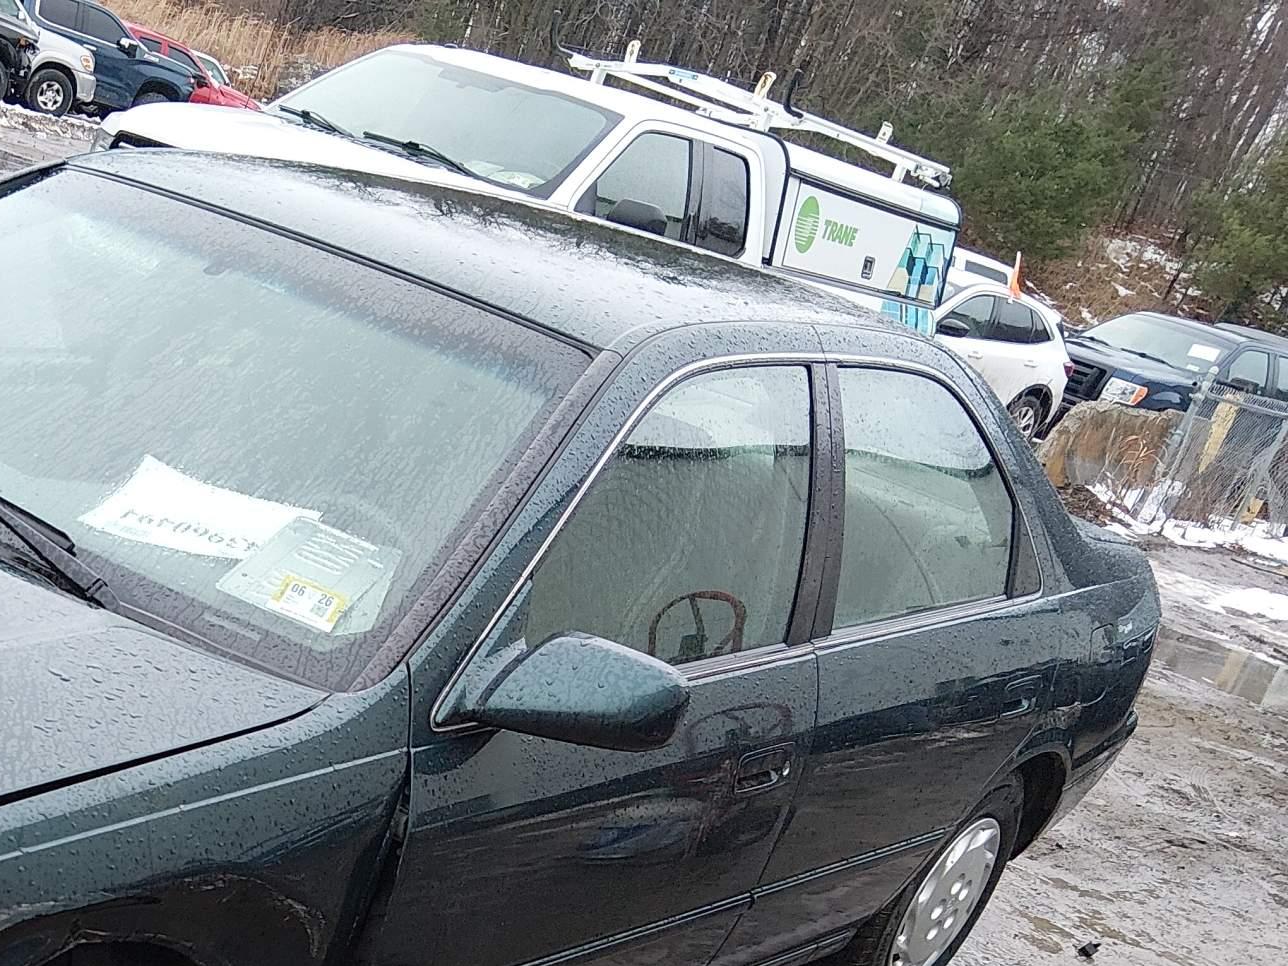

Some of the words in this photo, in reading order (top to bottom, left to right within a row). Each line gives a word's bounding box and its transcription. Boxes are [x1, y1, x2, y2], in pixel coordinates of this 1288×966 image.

[823, 220, 859, 247] TRANE
[291, 582, 306, 598] 06
[318, 593, 333, 608] 26
